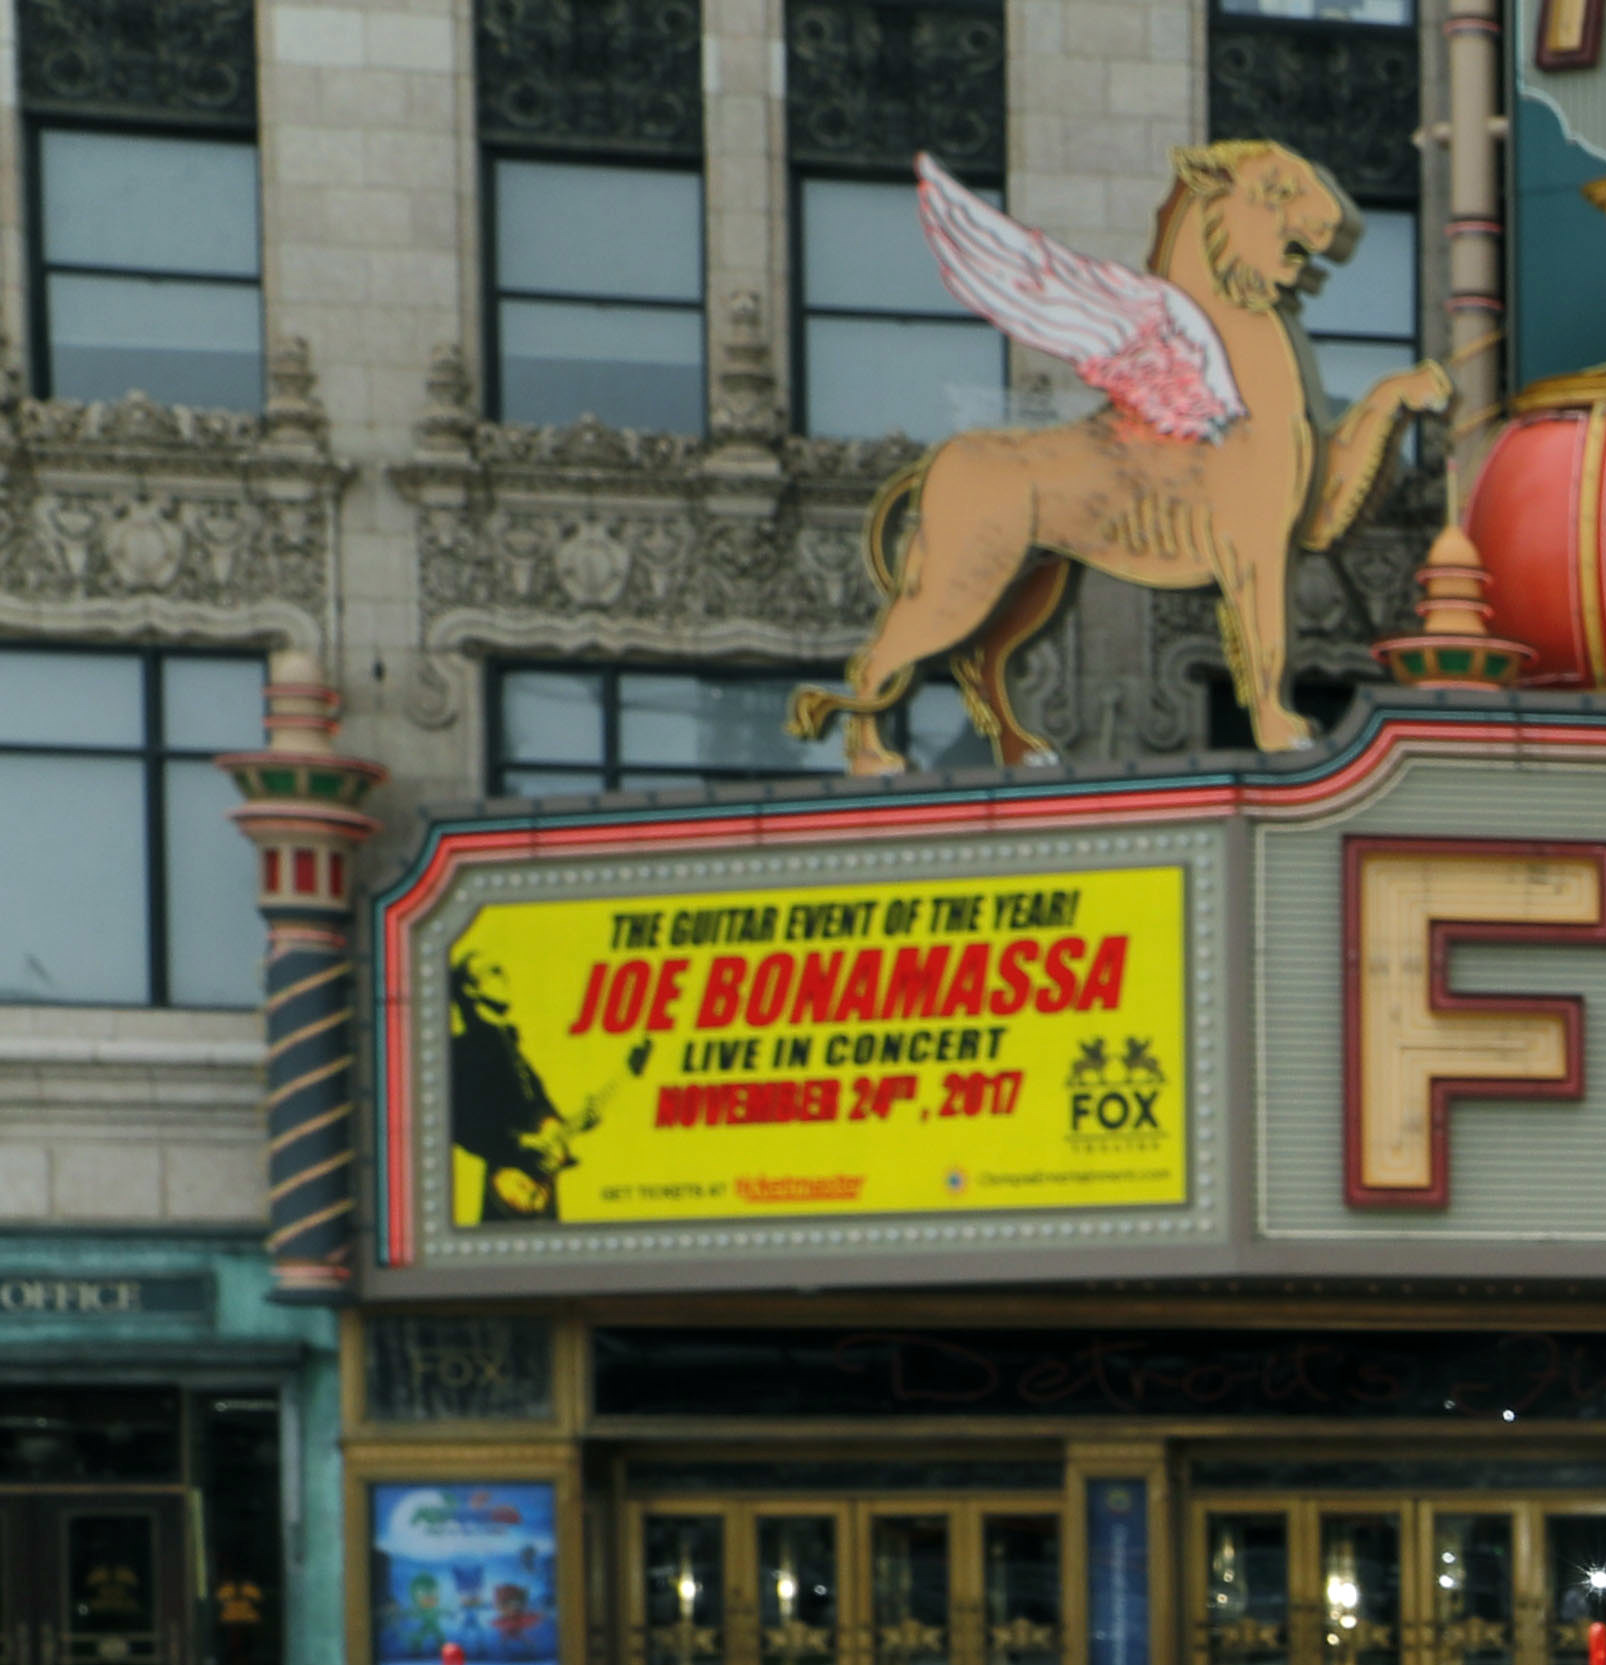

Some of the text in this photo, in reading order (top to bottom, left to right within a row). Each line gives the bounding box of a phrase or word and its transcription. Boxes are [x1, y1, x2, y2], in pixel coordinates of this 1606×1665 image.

[611, 889, 1081, 949] THE GUITAR EVENT OF THE YEAR!
[568, 934, 1130, 1035] JOE BONAMASSA
[682, 1027, 1007, 1073] LIVE IN CONCERT
[655, 1079, 840, 1128] NOVEMBER
[938, 1070, 1024, 1118] 2017
[1070, 1090, 1160, 1131] FOX
[0, 1281, 142, 1314] OFFICE
